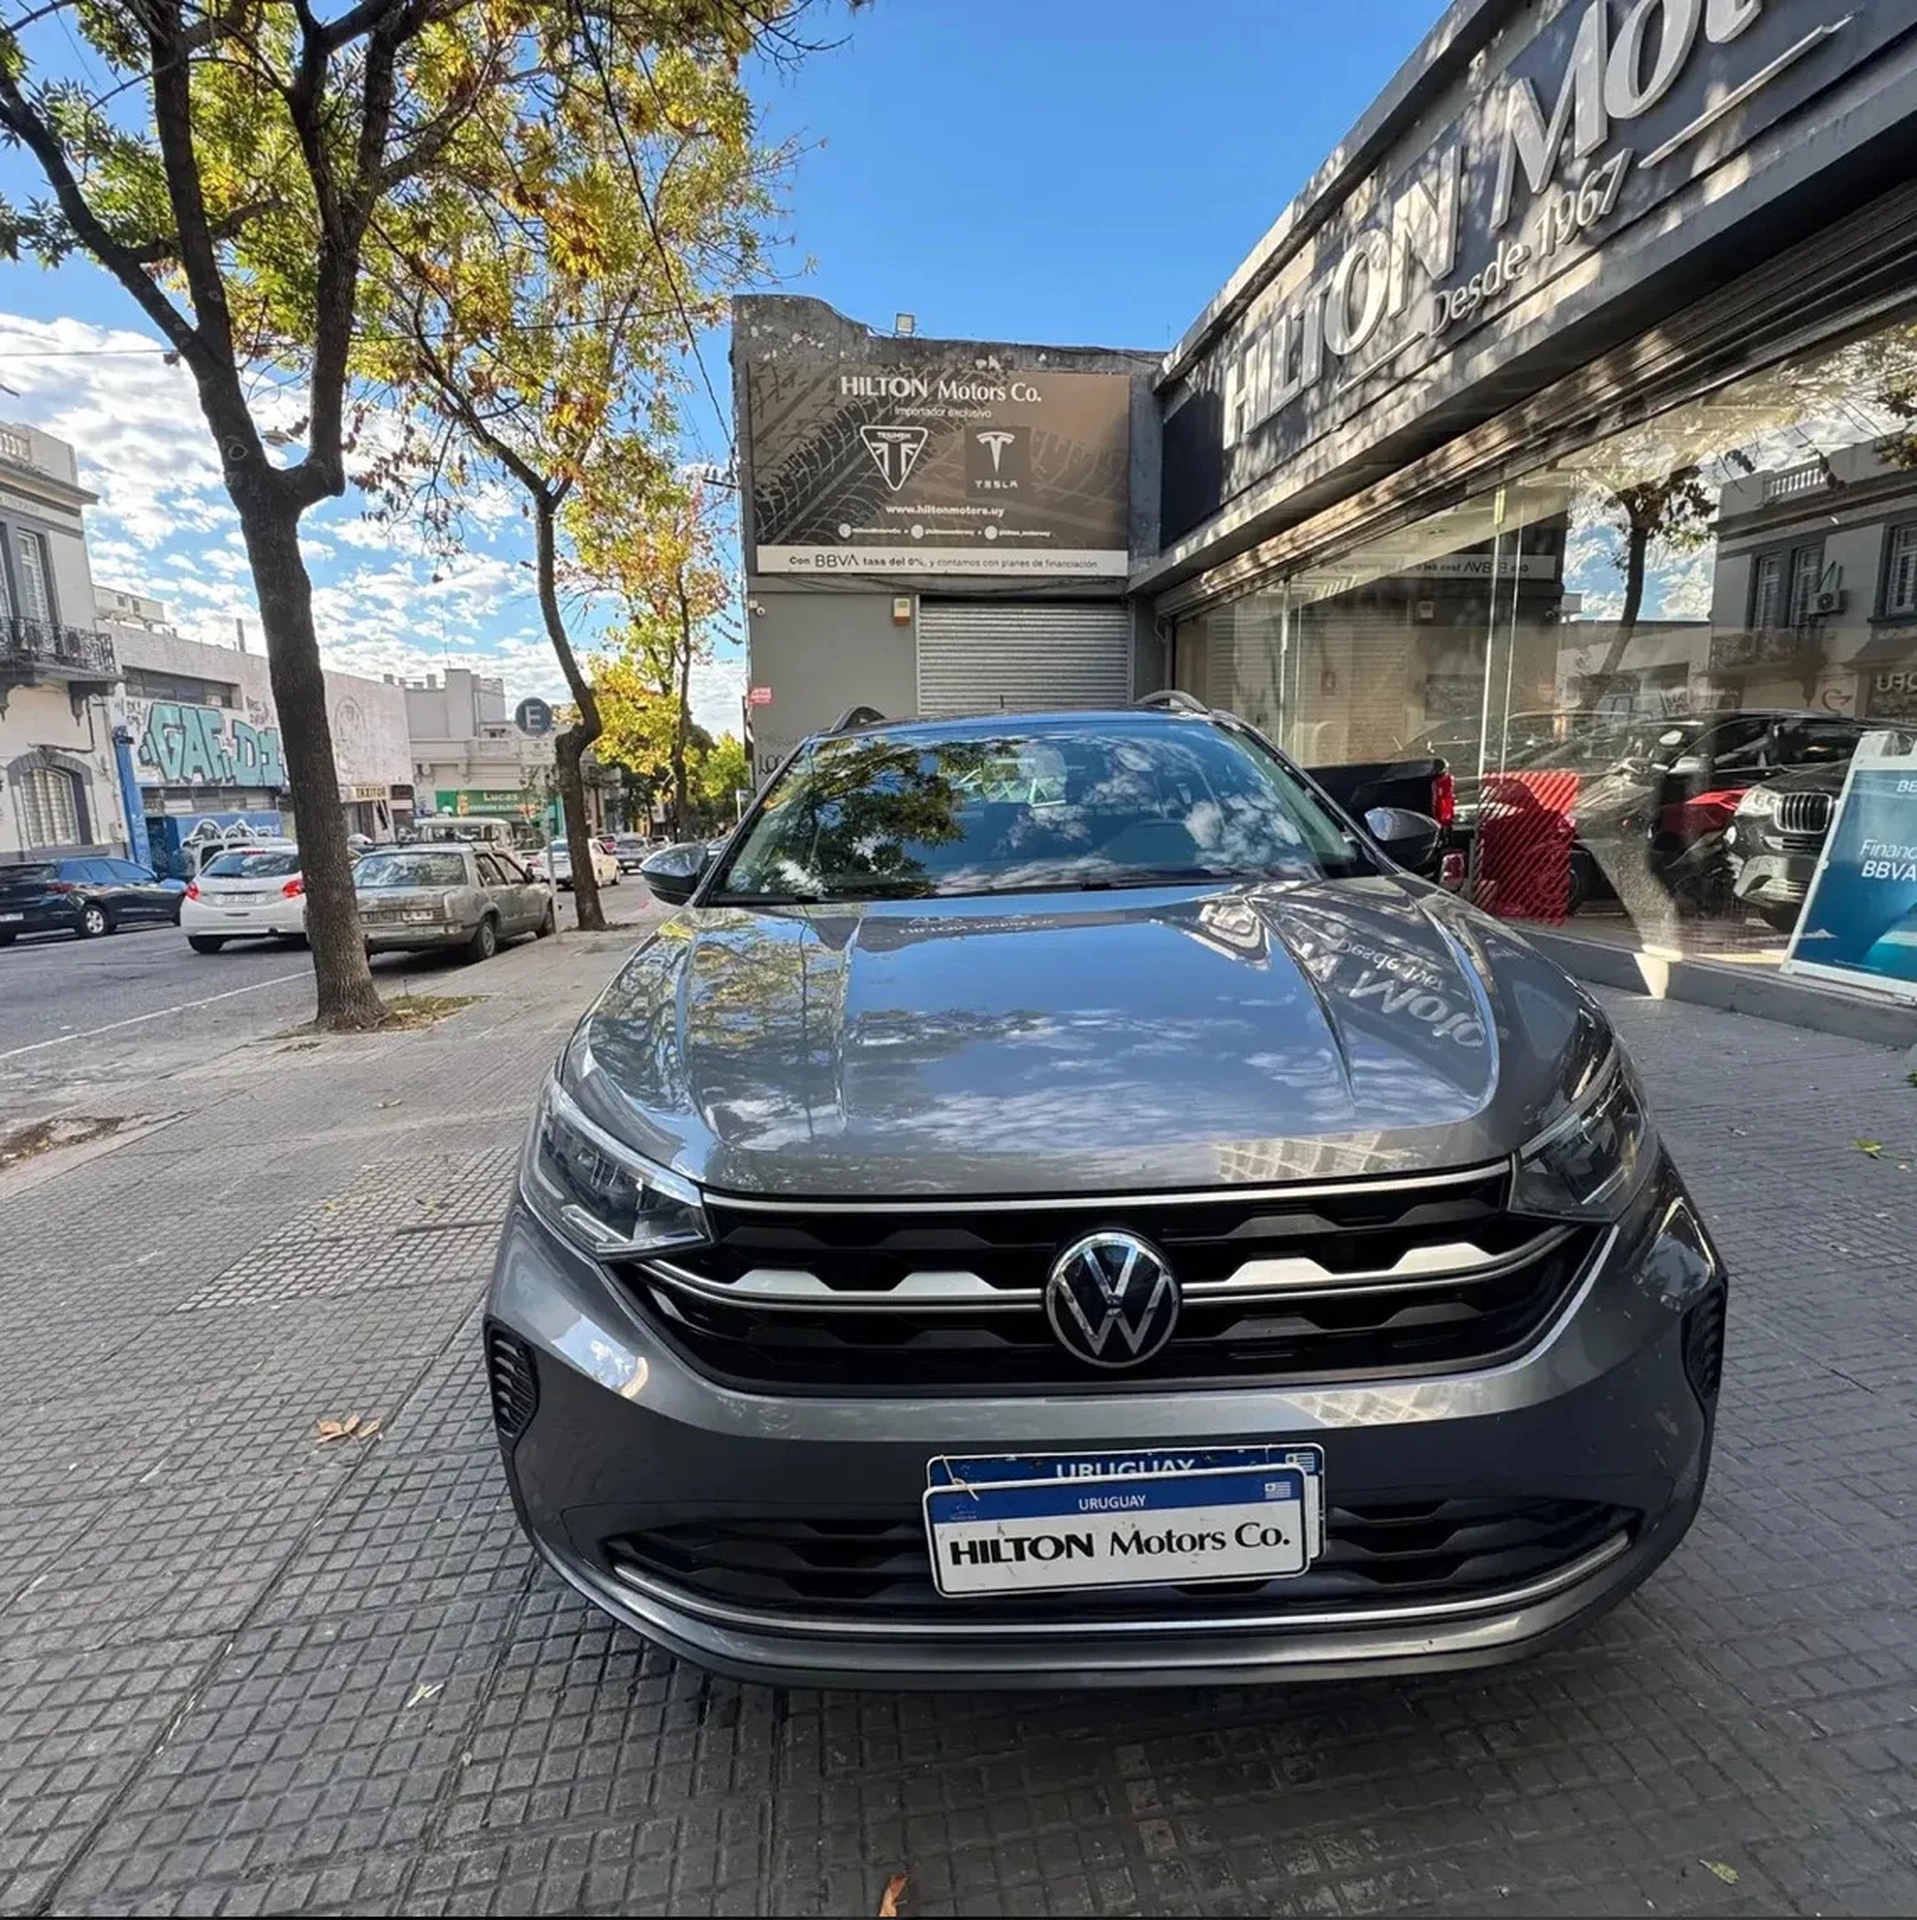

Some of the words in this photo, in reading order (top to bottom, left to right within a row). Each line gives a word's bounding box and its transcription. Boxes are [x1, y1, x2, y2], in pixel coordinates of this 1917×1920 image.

[1429, 240, 1529, 338] Desde
[1534, 148, 1634, 257] 1967
[1223, 144, 1462, 450] HILTON
[840, 376, 929, 398] HILTON
[937, 380, 1006, 401] Motors
[1010, 382, 1042, 402] Co.
[974, 480, 1018, 489] TESLA
[789, 555, 811, 565] Con
[815, 554, 860, 568] BBVA
[863, 556, 886, 567] tasa
[889, 557, 906, 567] del
[937, 558, 980, 567] contamos
[1001, 558, 1030, 569] planes
[1032, 558, 1044, 568] de
[525, 705, 543, 729] E
[1861, 860, 1917, 881] BBVA
[1078, 1494, 1147, 1511] URUGUAY
[949, 1532, 1095, 1566] HILTON
[1109, 1529, 1227, 1557] Motors
[1234, 1521, 1291, 1548] Co.
